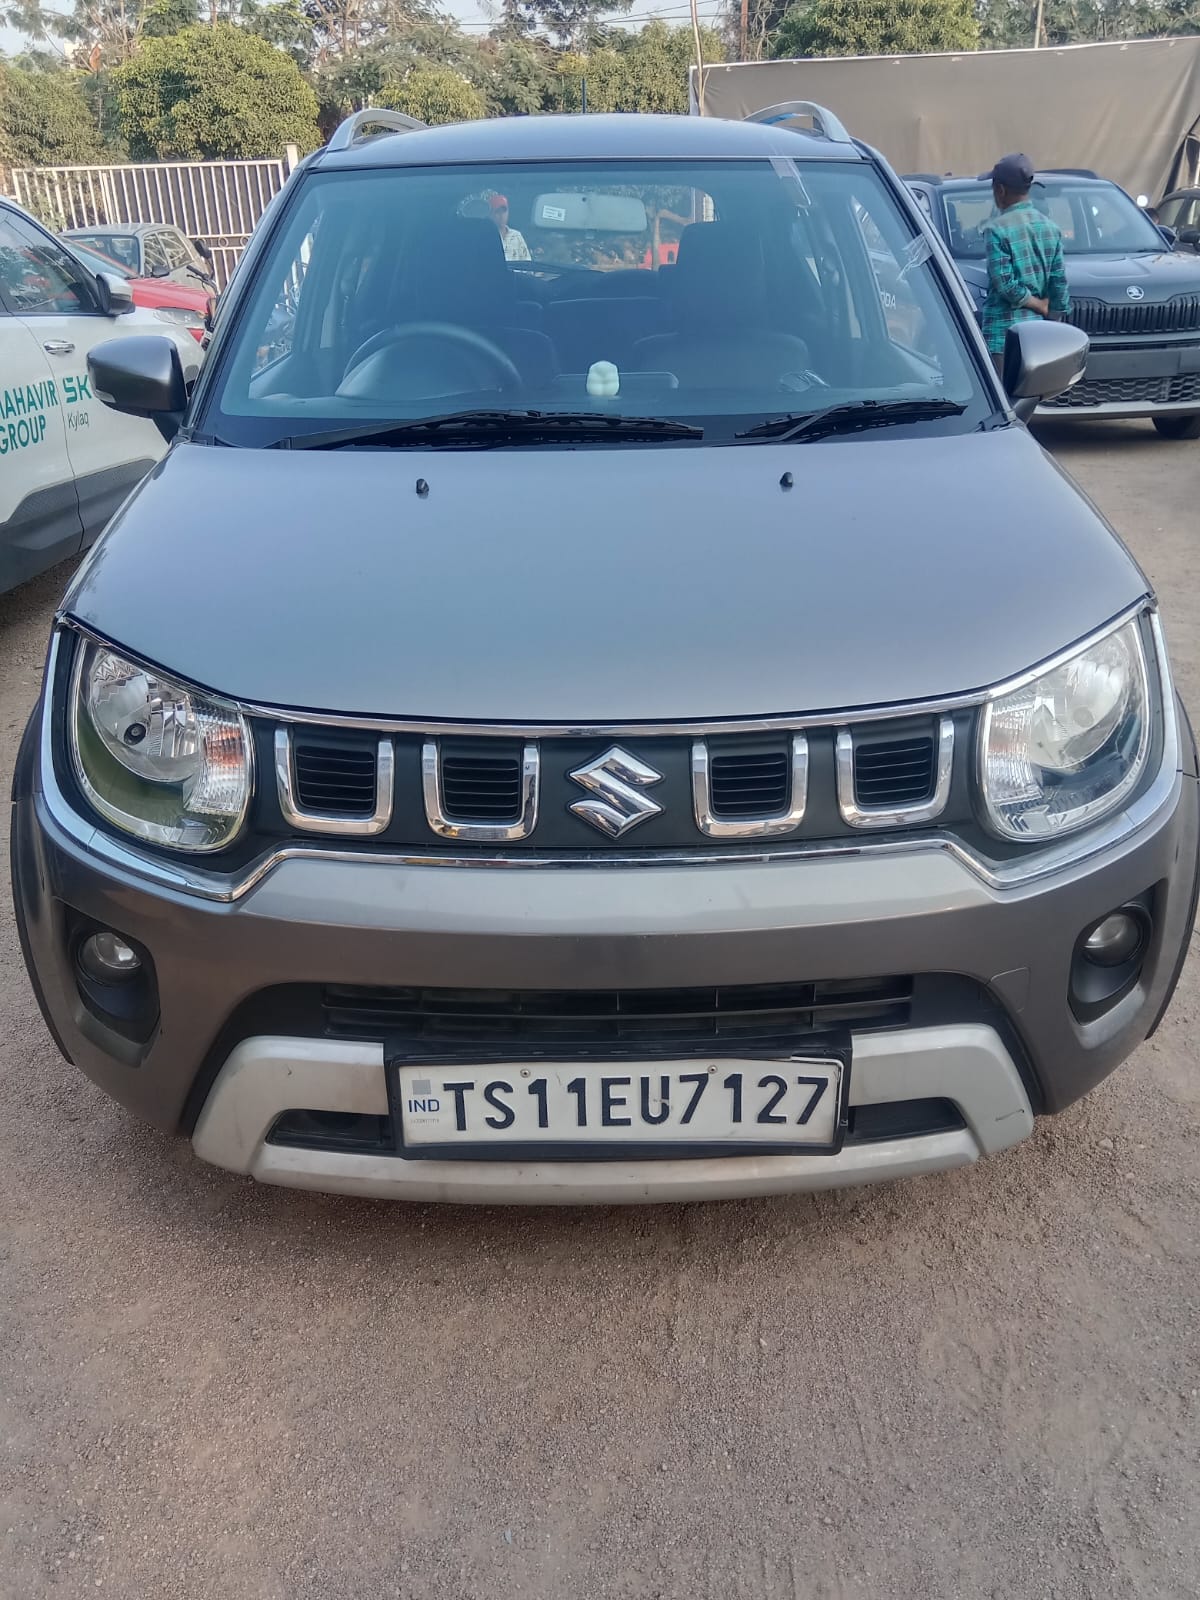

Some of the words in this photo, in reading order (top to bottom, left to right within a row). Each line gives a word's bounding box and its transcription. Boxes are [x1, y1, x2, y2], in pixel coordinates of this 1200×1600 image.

[0, 380, 58, 420] AHAVIR
[0, 415, 46, 454] GROUP
[67, 411, 90, 431] Kylaq
[408, 1099, 440, 1112] IND
[443, 1073, 829, 1131] TS11EU7127
